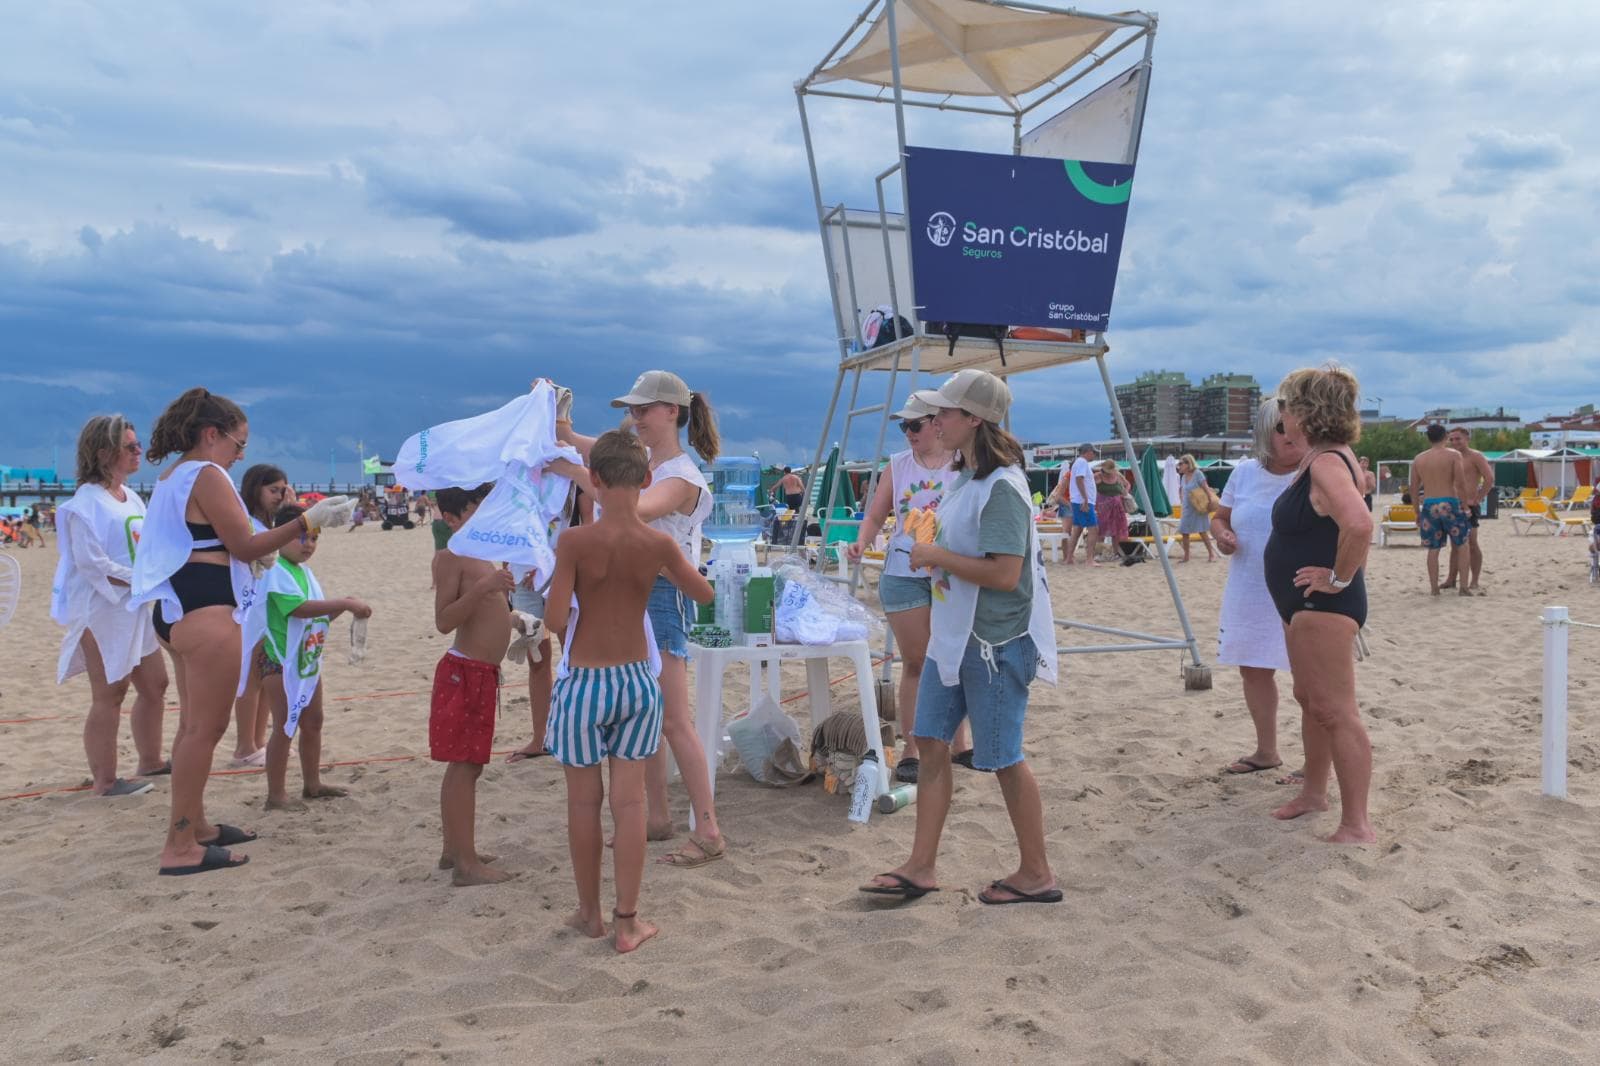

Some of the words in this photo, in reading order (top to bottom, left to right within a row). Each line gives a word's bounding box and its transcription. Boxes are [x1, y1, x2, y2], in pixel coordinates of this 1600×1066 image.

[962, 221, 1004, 245] San
[1009, 226, 1109, 254] Cristóbal
[962, 246, 1003, 259] Seguros
[1048, 302, 1075, 312] Grupo
[1048, 311, 1063, 319] San
[1064, 312, 1100, 321] Cristóbal
